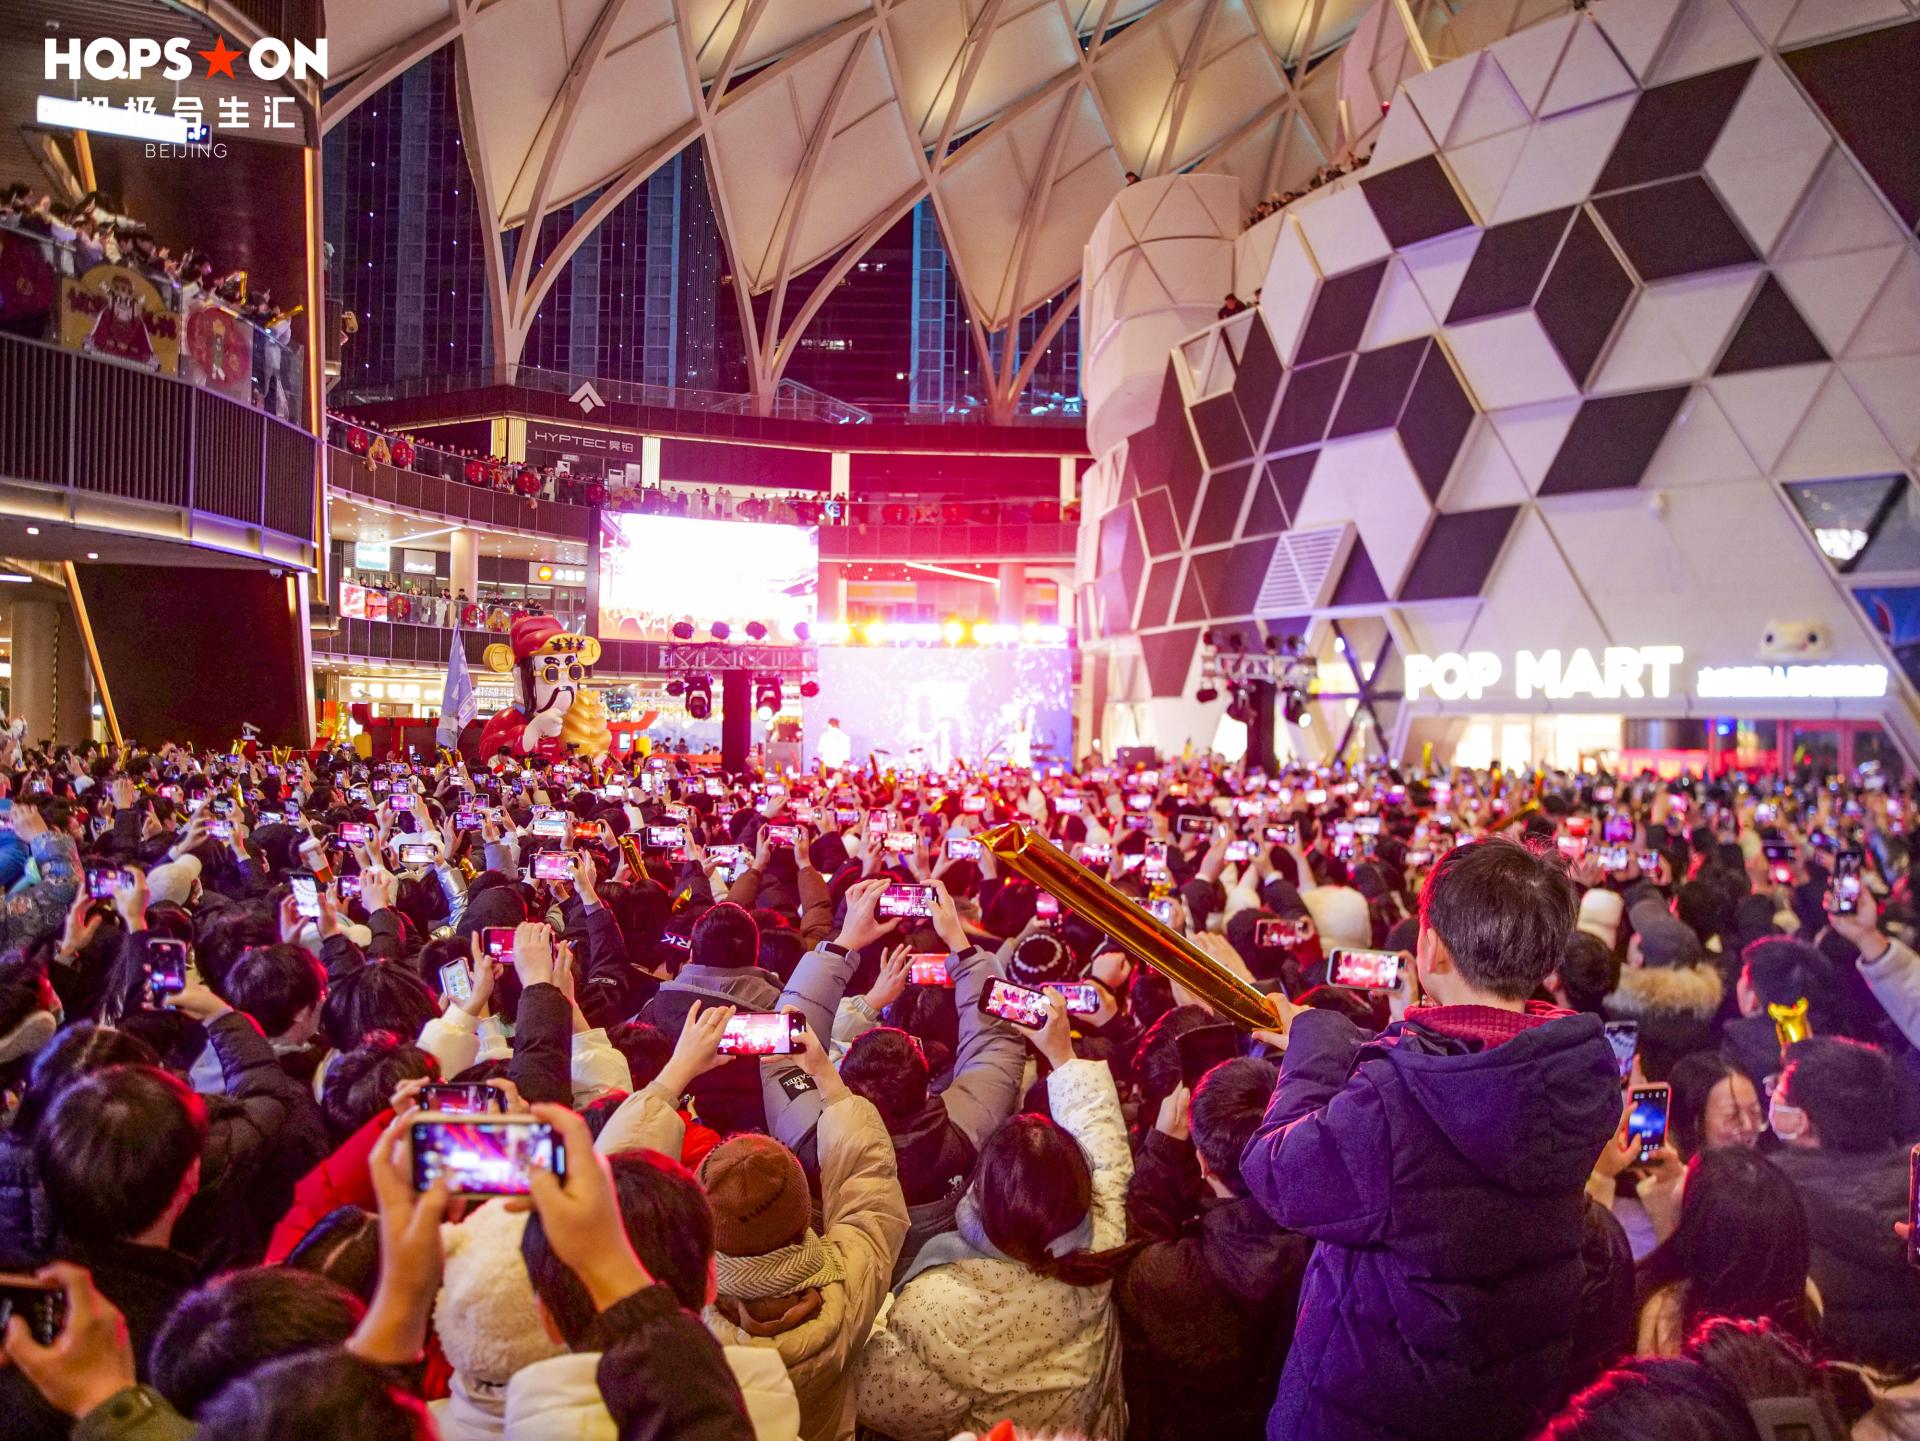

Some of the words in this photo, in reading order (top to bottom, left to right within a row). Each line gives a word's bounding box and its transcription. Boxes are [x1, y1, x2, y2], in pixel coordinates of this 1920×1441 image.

[535, 431, 607, 449] HYPTEC
[1404, 651, 1502, 701] POP
[1516, 645, 1684, 699] MART
